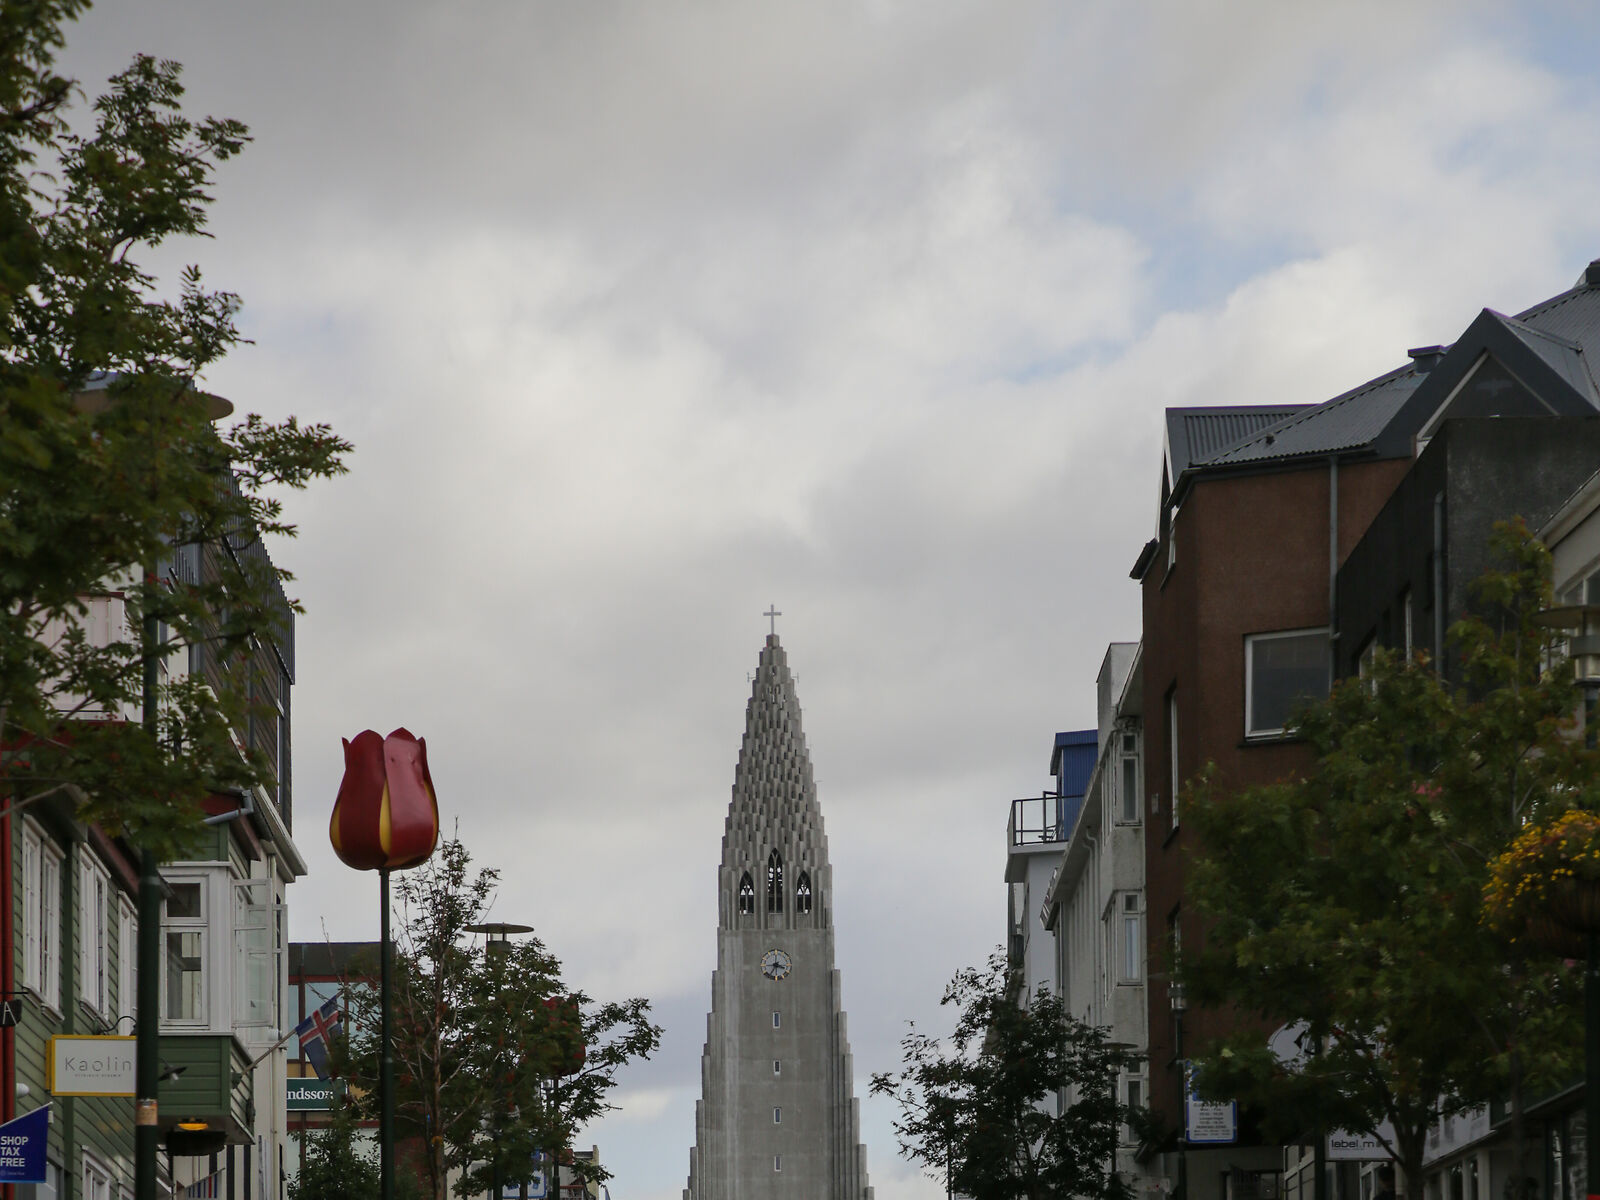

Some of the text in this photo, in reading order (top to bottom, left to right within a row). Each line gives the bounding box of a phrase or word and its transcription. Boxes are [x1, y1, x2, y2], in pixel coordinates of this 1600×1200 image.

[65, 1056, 132, 1072] Kaolin
[0, 1135, 29, 1146] SHOP
[0, 1146, 21, 1156] TAX
[0, 1157, 26, 1168] FREE
